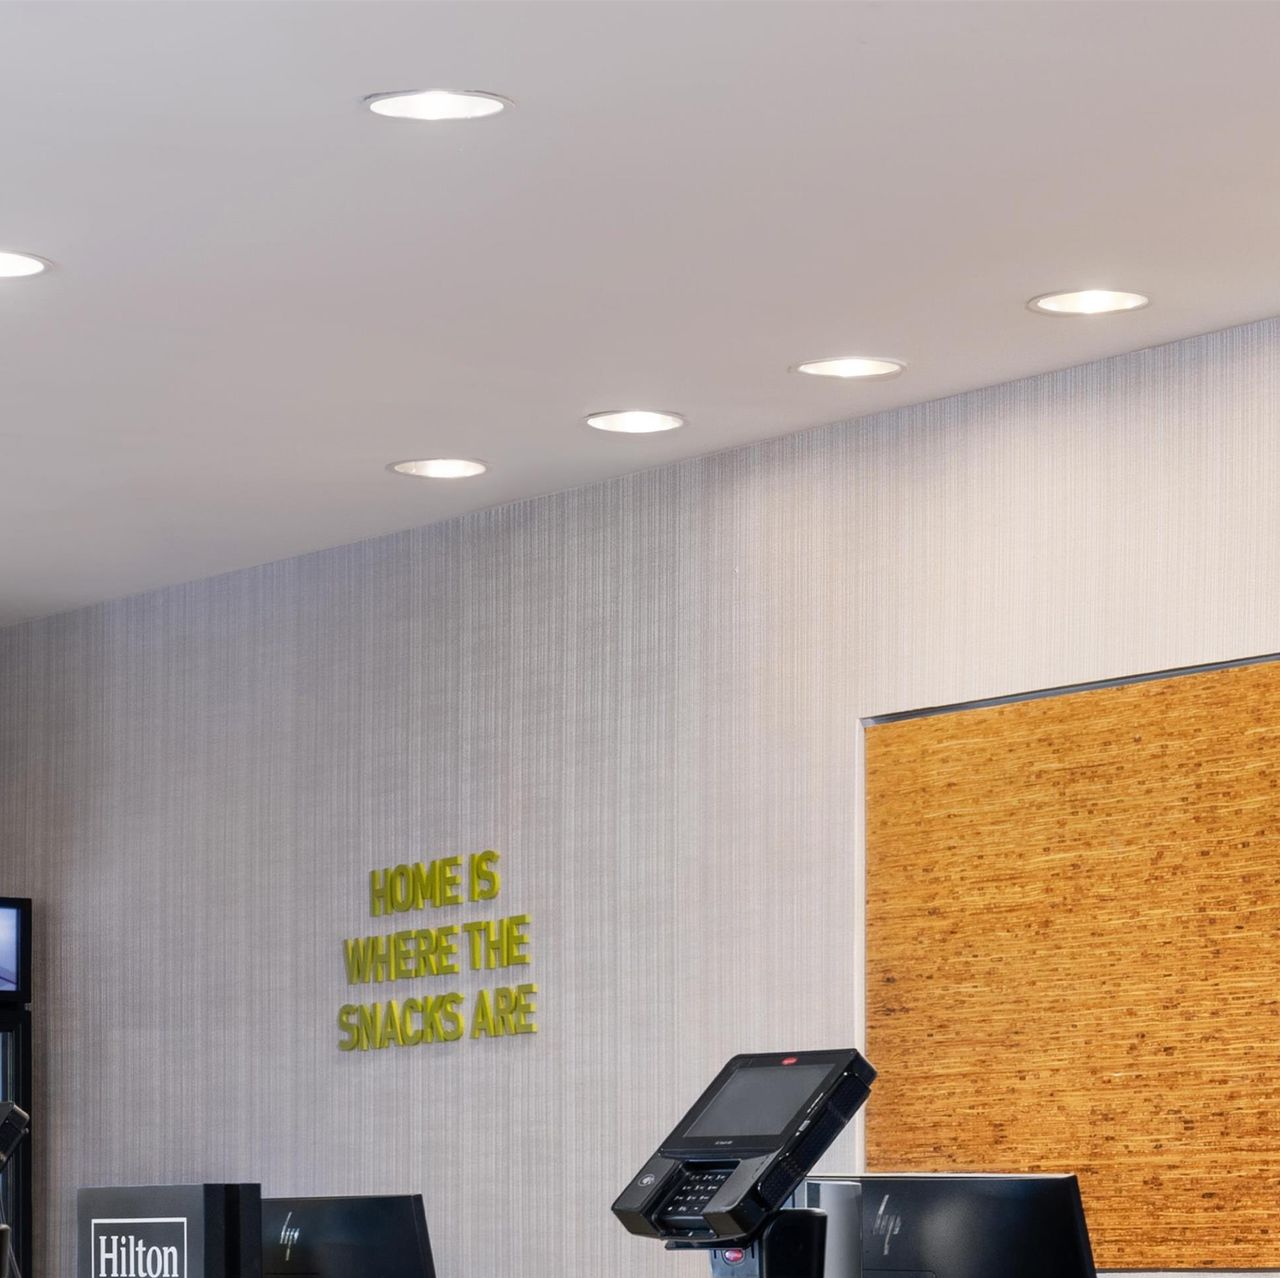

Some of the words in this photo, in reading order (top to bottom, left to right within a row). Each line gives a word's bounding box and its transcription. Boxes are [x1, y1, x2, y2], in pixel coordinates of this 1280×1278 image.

[370, 856, 462, 917] HOME
[469, 850, 501, 902] IS
[344, 924, 460, 985] WHERE
[462, 913, 532, 970] THE
[338, 991, 465, 1051] SNACKS
[471, 982, 538, 1039] ARE
[99, 1235, 179, 1278] Hilton
